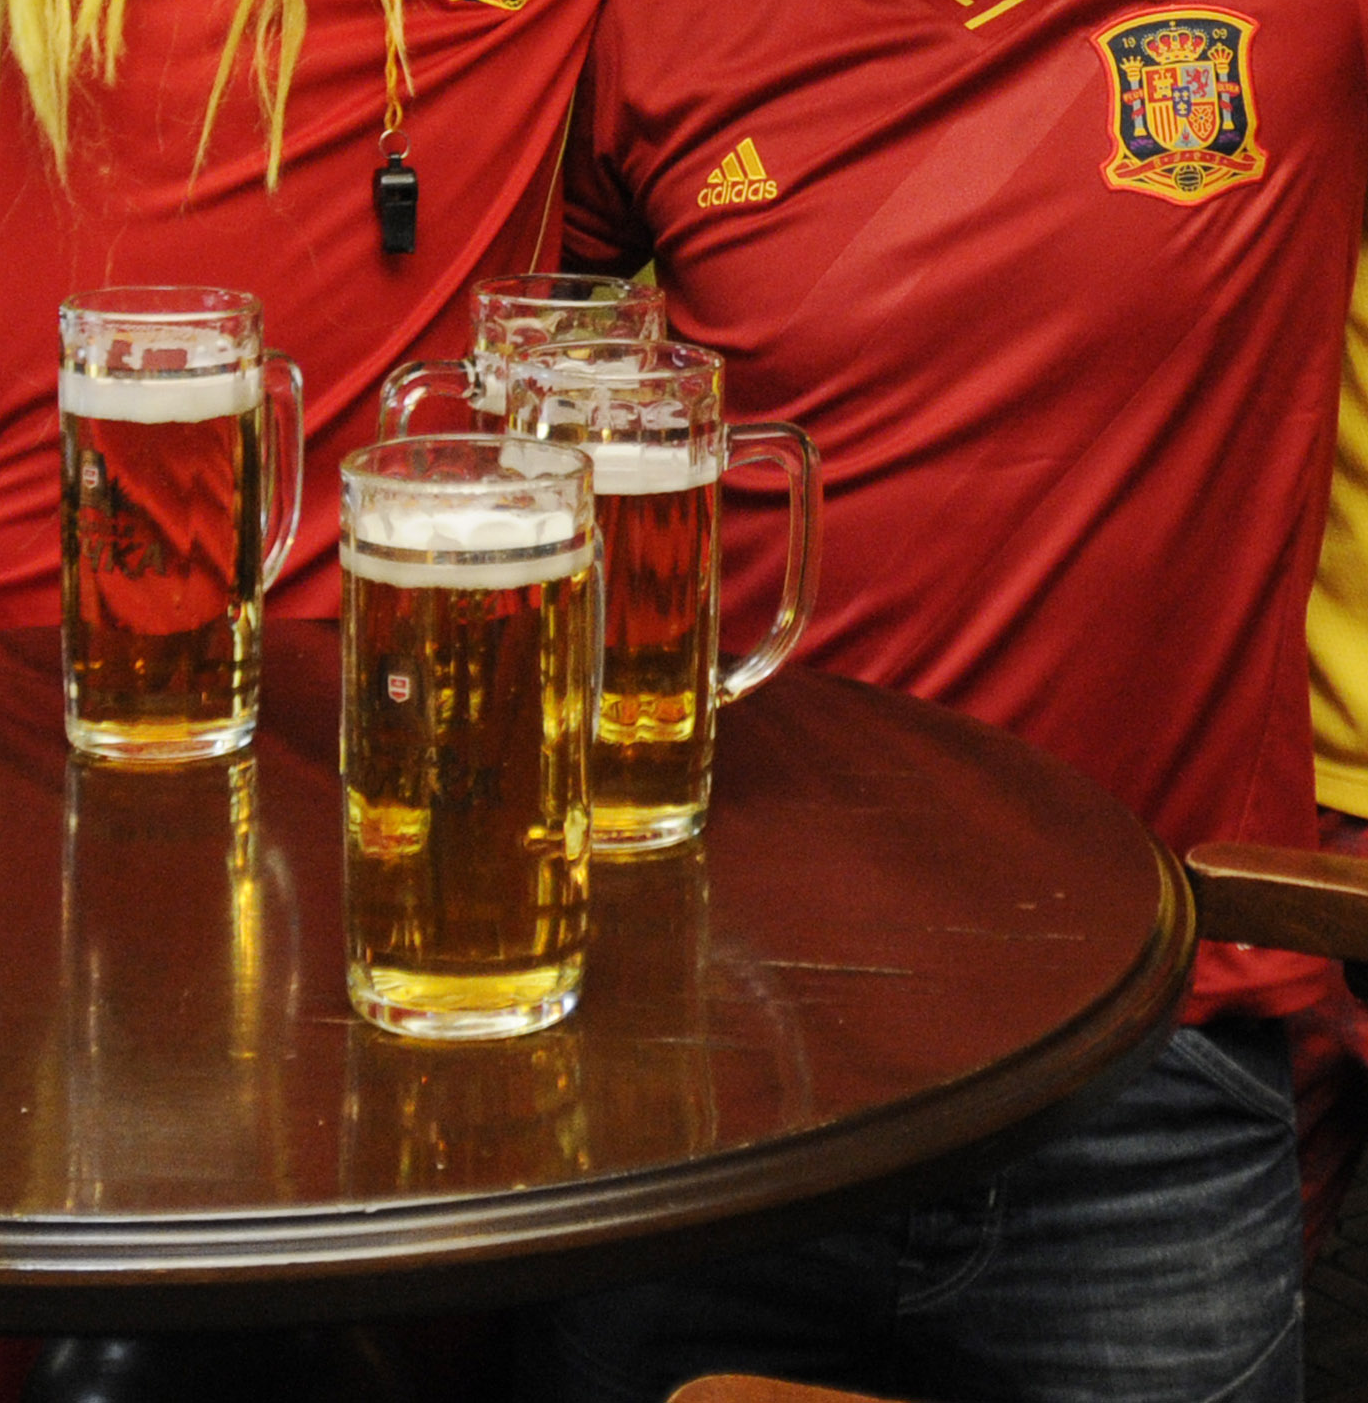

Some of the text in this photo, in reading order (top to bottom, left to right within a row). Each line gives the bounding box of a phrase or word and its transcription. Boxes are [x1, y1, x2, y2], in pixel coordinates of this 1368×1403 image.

[1212, 28, 1228, 39] 09
[1122, 36, 1137, 49] 19
[697, 179, 778, 208] adidas
